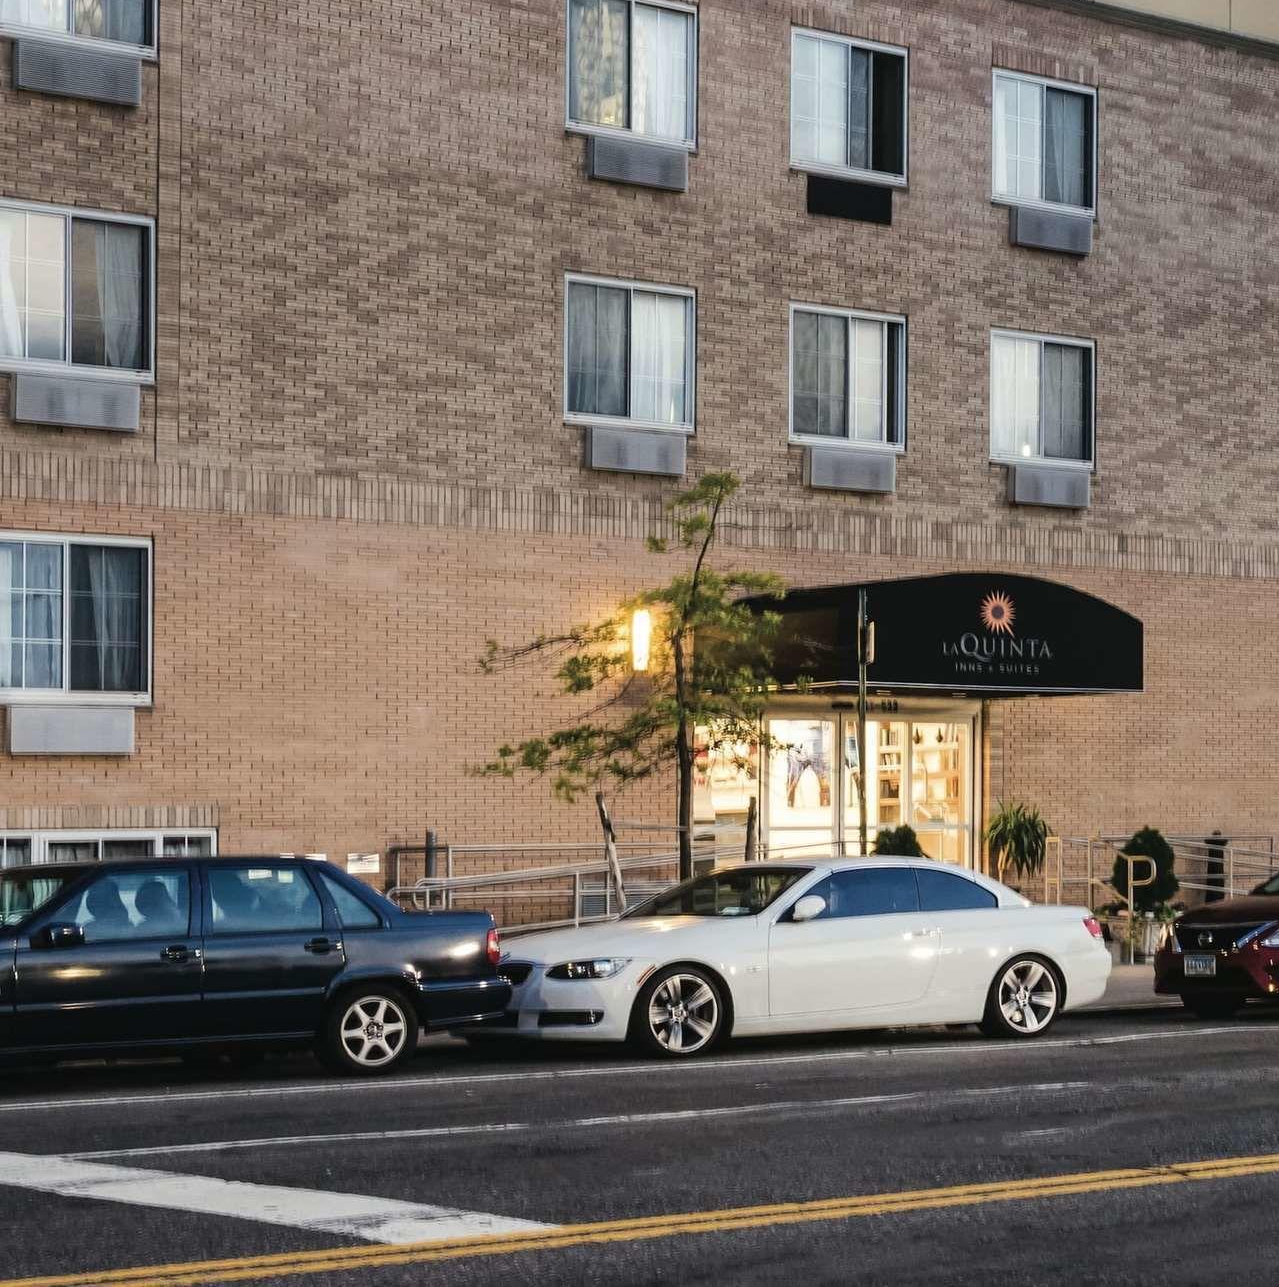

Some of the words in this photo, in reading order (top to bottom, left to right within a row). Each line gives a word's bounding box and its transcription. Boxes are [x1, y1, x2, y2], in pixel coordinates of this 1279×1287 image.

[942, 641, 959, 656] LA
[960, 632, 1052, 663] QUINTA
[955, 661, 983, 673] INNS
[999, 663, 1040, 674] SUITES
